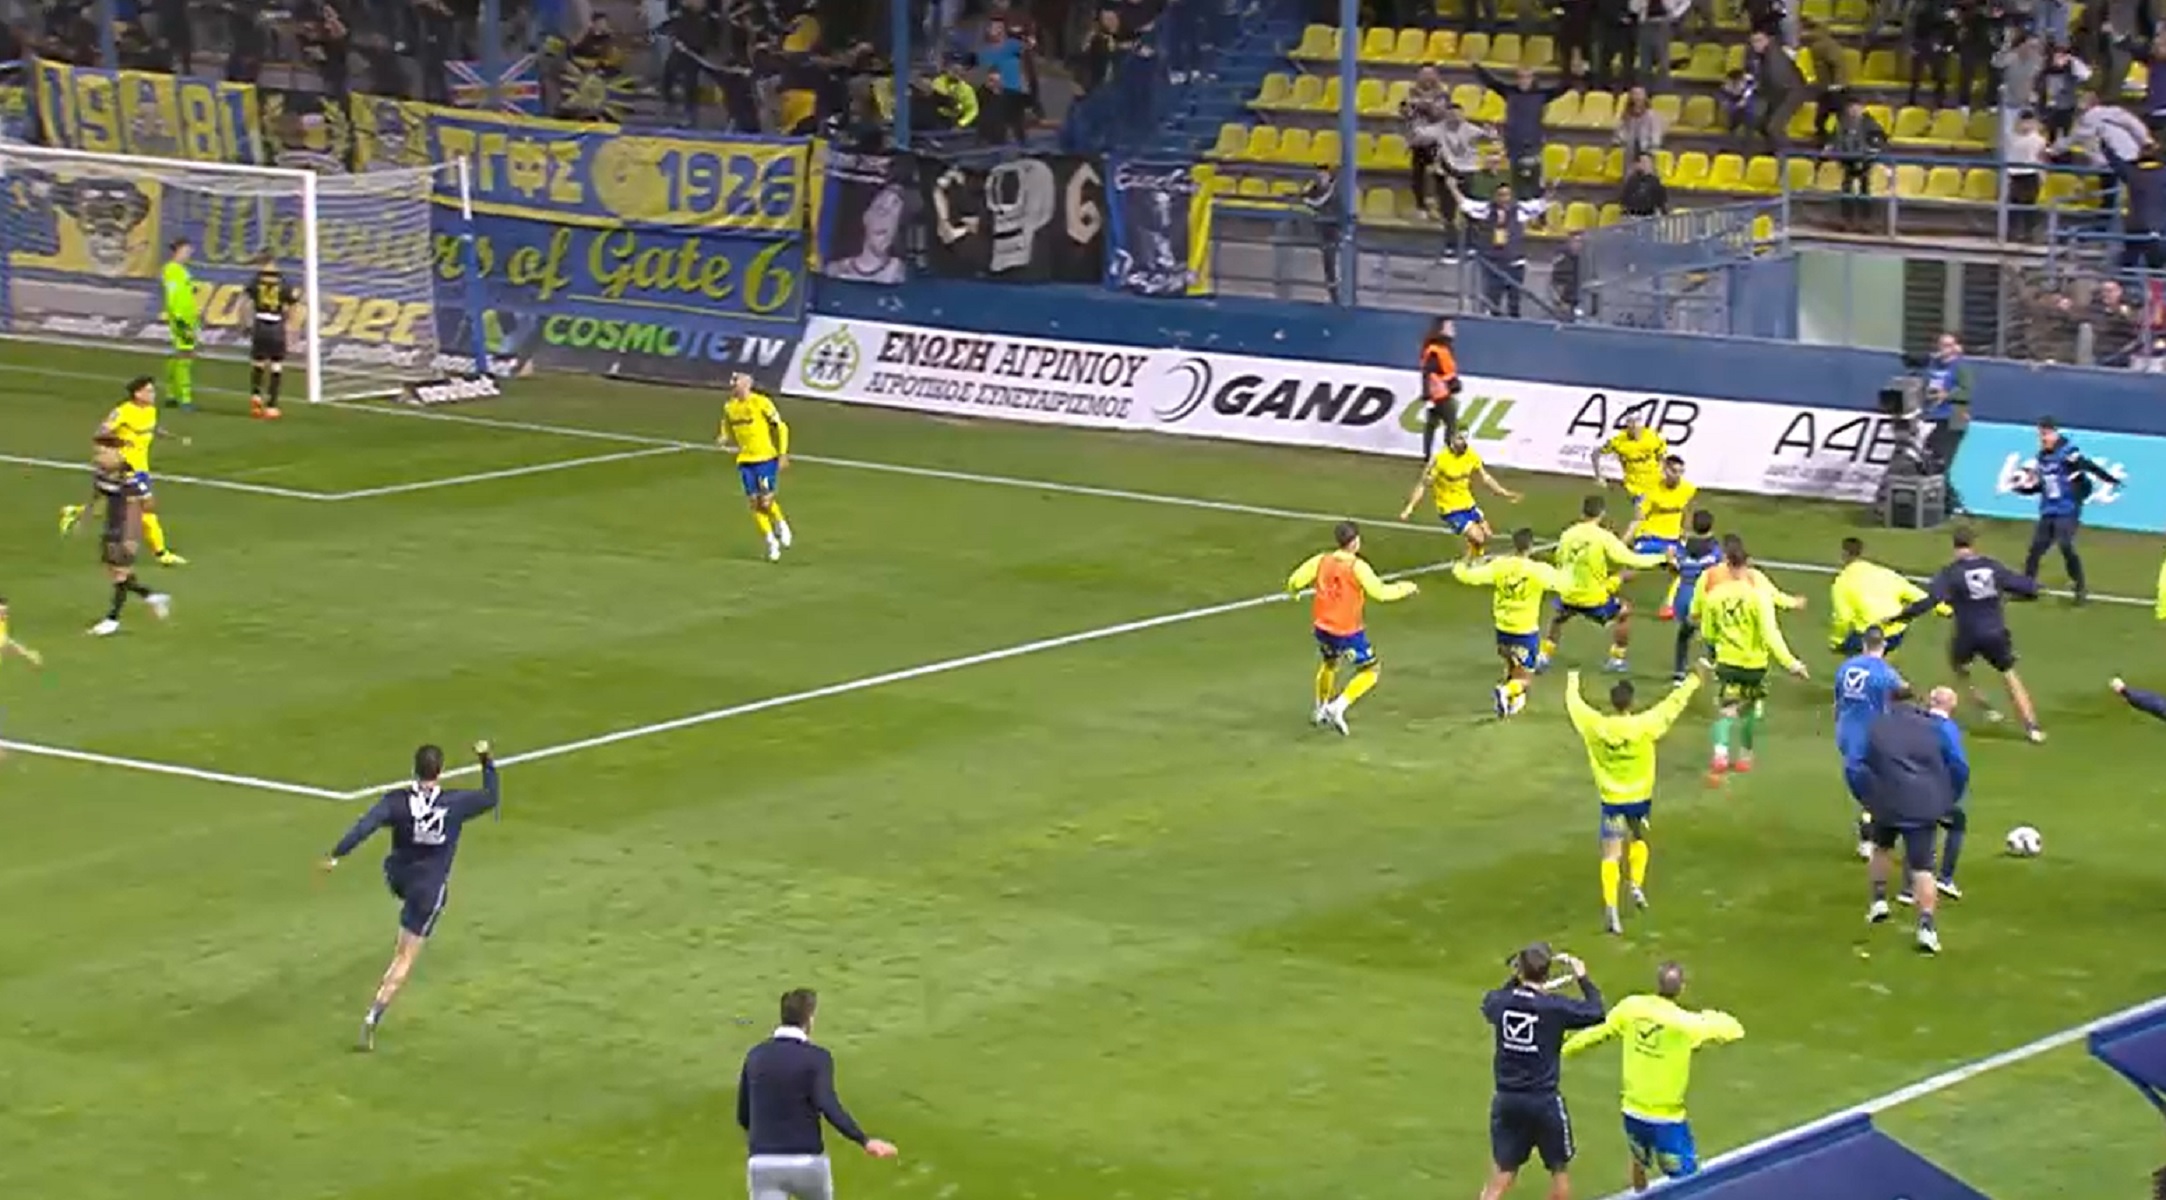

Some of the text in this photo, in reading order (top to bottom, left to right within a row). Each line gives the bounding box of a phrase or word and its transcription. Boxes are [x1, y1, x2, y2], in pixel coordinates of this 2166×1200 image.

[659, 147, 796, 219] 1926
[507, 227, 573, 300] of
[588, 227, 733, 299] Gate
[742, 238, 794, 314] 6
[543, 313, 734, 362] COSMOTE
[876, 331, 1148, 388] ΕΝΩΣΗ ΑΓΡΙΝΙΟΥ
